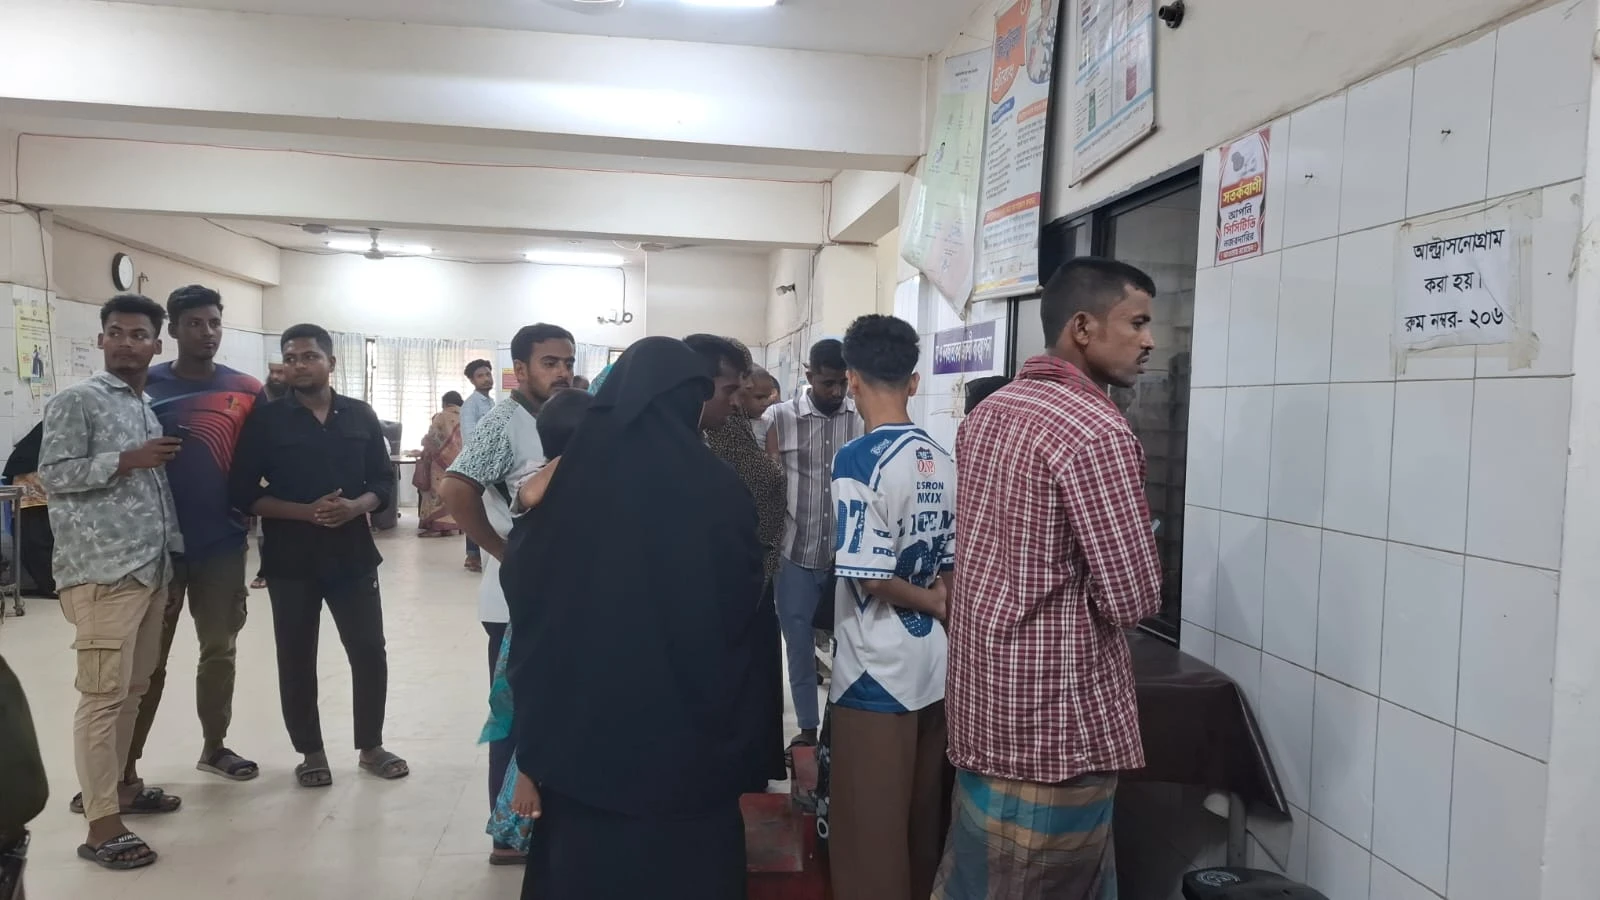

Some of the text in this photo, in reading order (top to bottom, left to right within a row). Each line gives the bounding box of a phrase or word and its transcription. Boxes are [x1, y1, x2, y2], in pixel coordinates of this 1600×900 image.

[1424, 275, 1448, 294] করা
[1404, 315, 1426, 332] রুম
[1469, 307, 1504, 328] ২০৬
